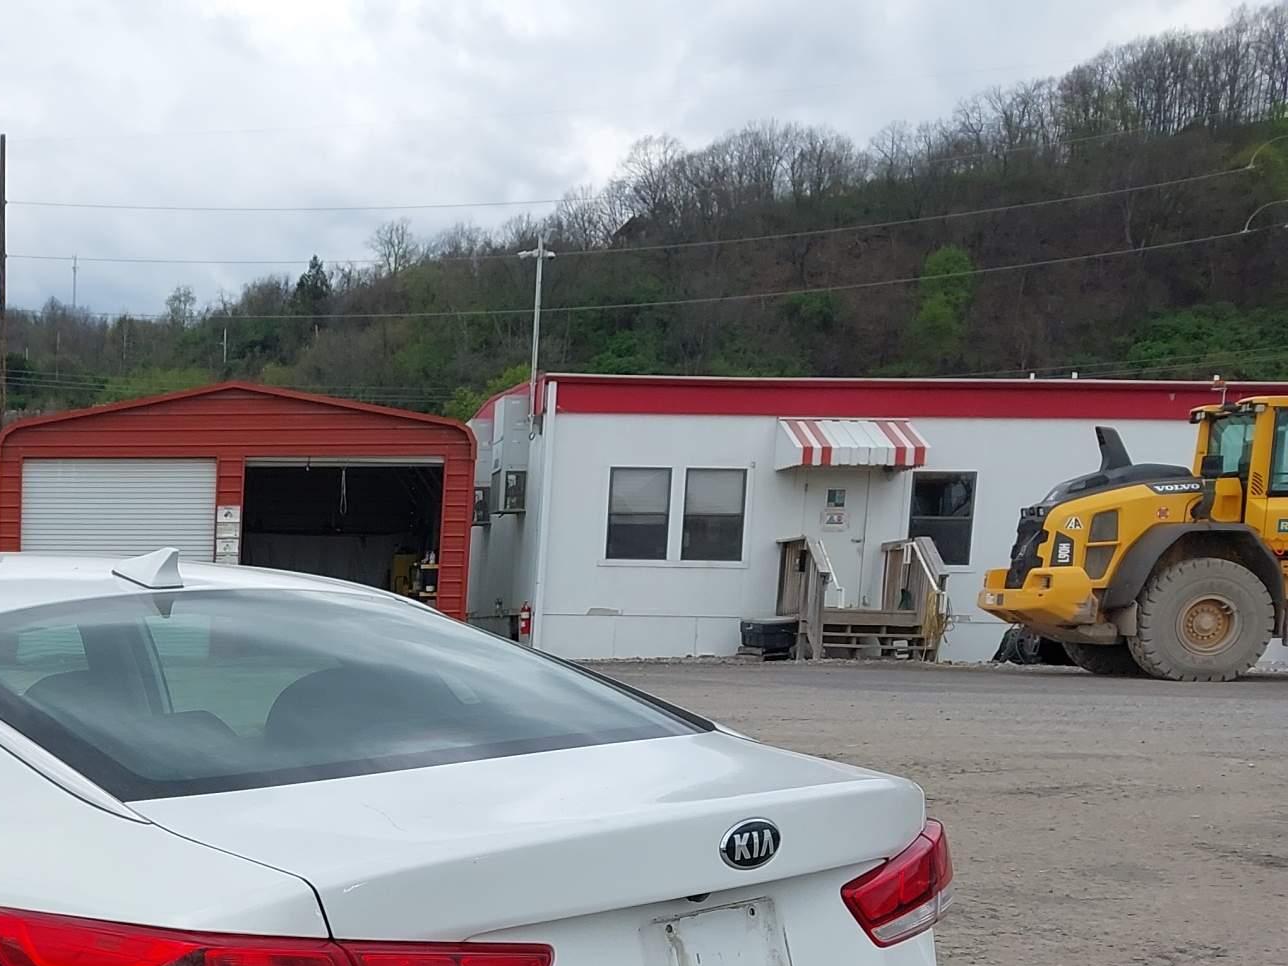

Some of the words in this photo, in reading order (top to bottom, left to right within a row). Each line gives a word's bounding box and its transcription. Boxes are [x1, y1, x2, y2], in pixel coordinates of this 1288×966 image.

[1153, 483, 1200, 492] VOLVO
[1057, 543, 1071, 563] L90H
[733, 828, 774, 861] KIA
